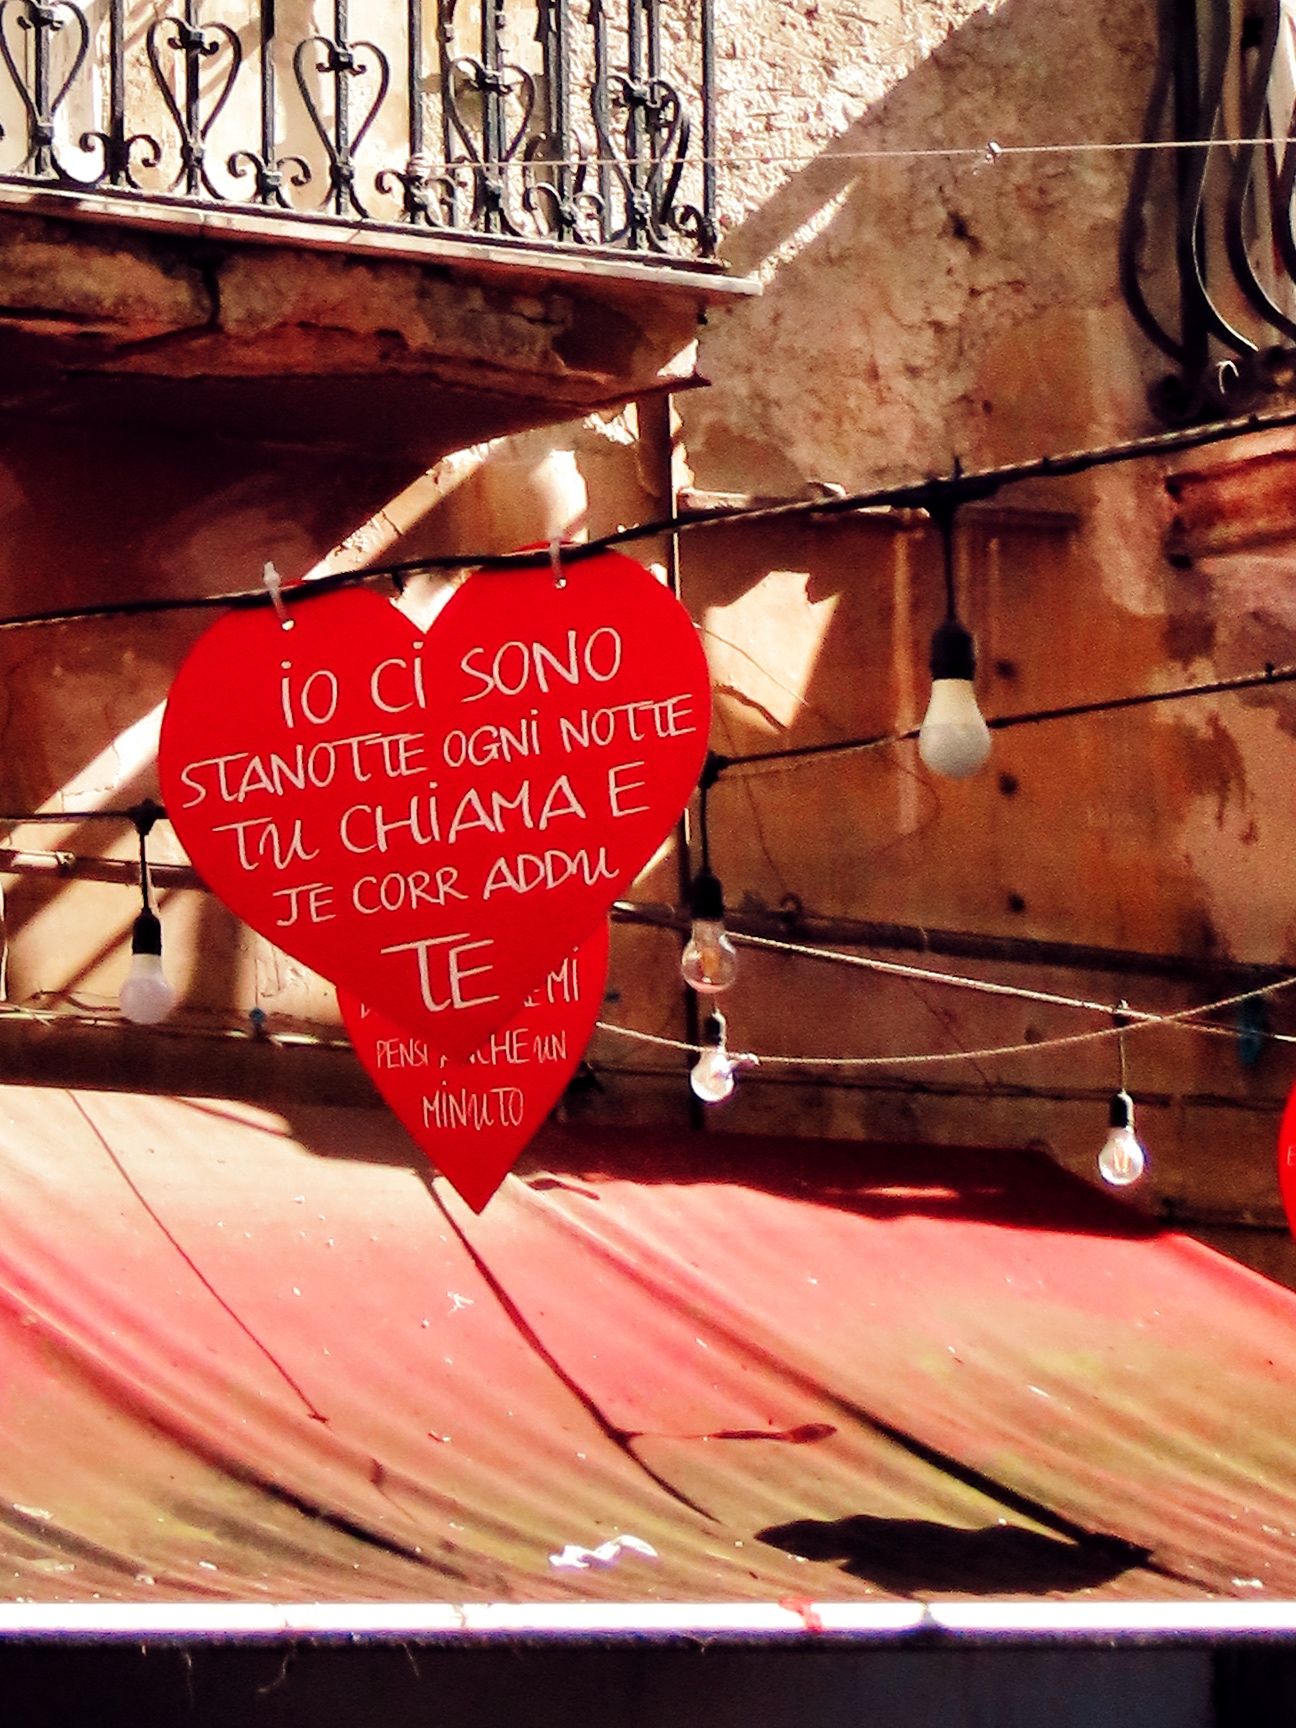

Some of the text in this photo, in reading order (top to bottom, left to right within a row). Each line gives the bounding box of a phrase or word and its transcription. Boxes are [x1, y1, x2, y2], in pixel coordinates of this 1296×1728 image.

[461, 627, 622, 703] SONO
[181, 733, 427, 808] STANOTTE
[560, 694, 697, 753] NOTTE
[212, 817, 320, 871] TU
[607, 761, 650, 817] E
[273, 846, 620, 927] JE CORR ADDU
[381, 933, 500, 1012] TE
[376, 1038, 428, 1069] PENSI
[533, 1030, 567, 1064] UN
